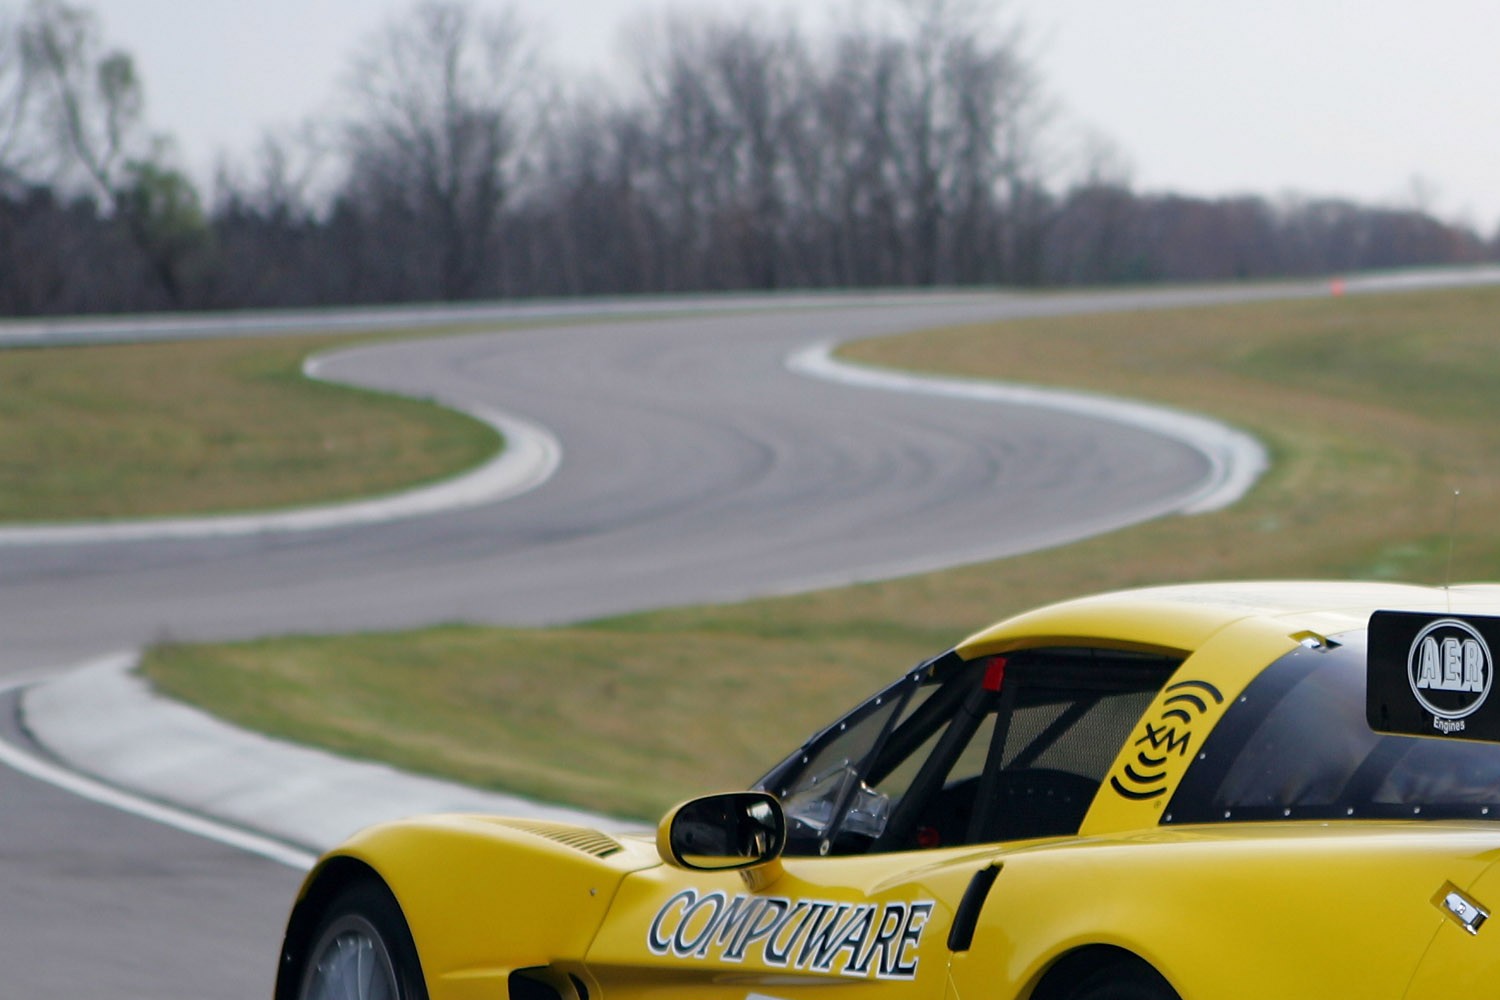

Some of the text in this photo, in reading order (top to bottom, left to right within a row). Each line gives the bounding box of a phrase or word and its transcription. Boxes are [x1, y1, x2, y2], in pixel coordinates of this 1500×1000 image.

[1416, 636, 1484, 692] AER
[1135, 723, 1192, 757] XM
[1433, 716, 1465, 734] Engines
[647, 888, 935, 980] COMPUWARE
